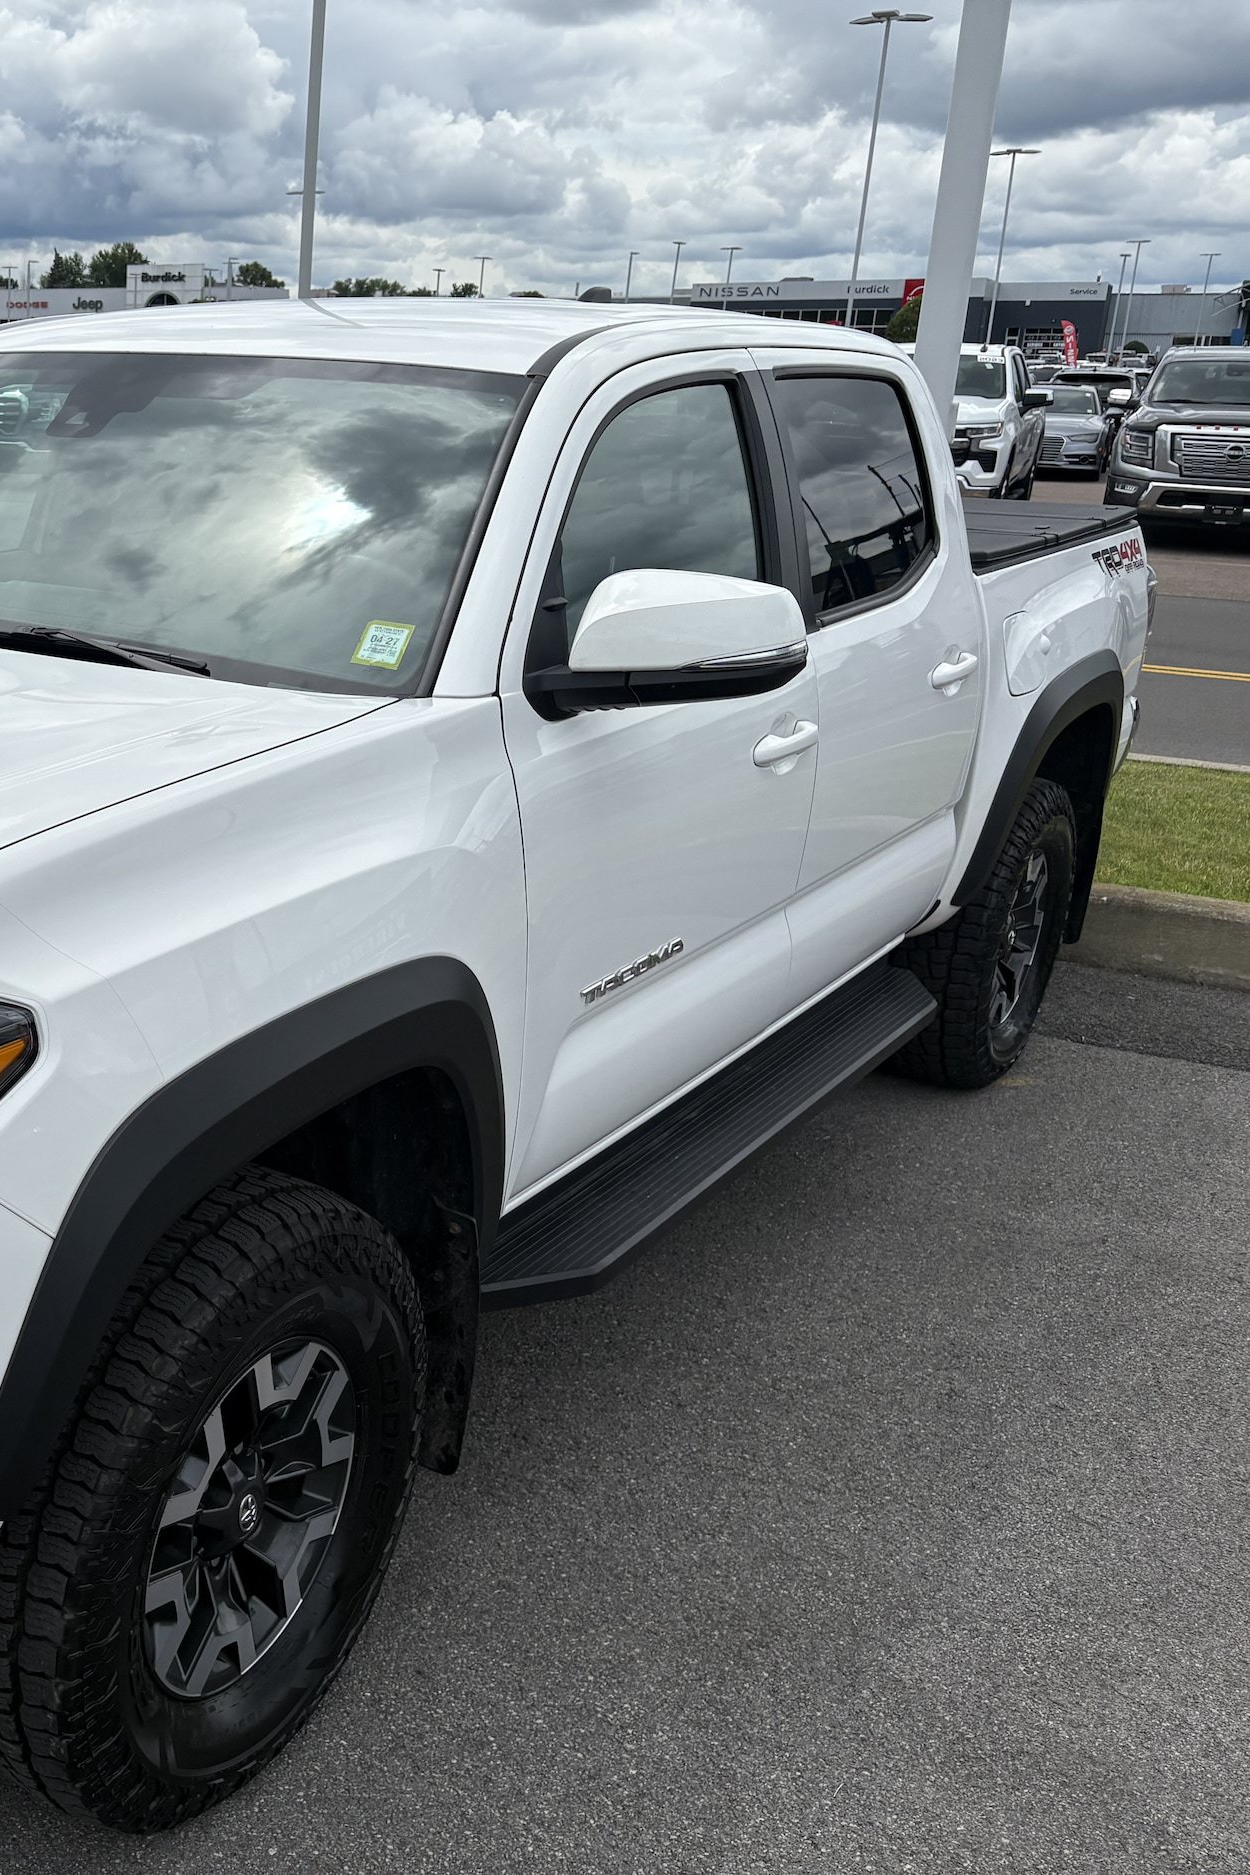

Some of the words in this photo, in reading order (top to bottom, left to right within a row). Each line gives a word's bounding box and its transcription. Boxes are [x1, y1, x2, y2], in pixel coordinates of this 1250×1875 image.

[141, 271, 186, 282] Burdick
[699, 286, 780, 297] NISSAN
[847, 285, 890, 295] urdick
[6, 301, 48, 309] DODGE
[72, 297, 103, 312] Jeep
[580, 936, 684, 1005] TACOMA
